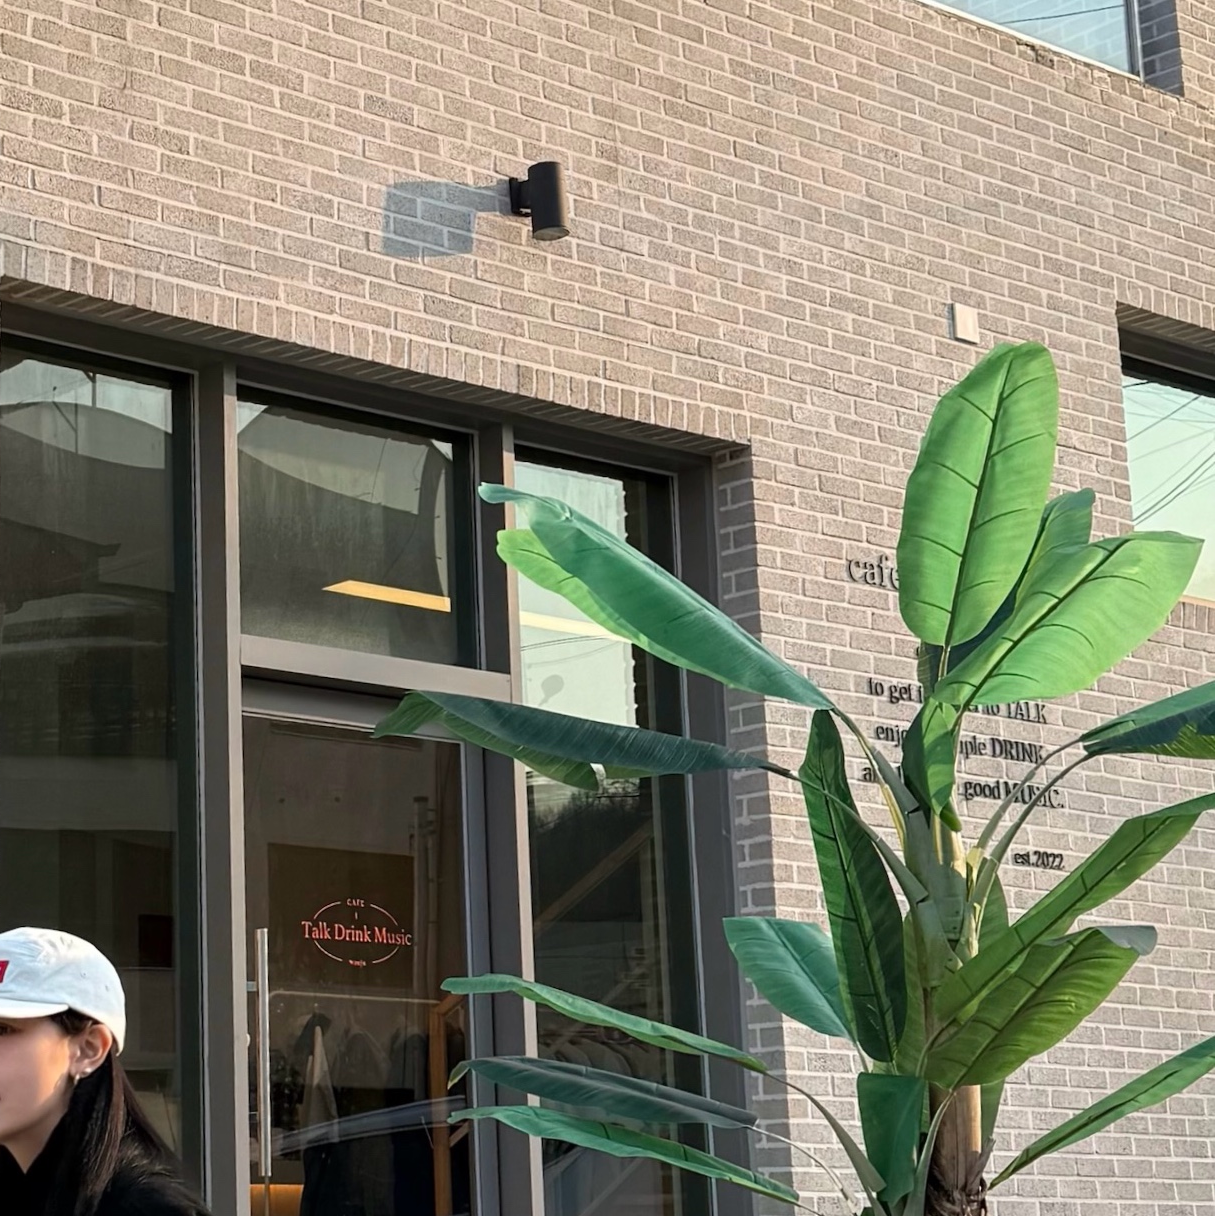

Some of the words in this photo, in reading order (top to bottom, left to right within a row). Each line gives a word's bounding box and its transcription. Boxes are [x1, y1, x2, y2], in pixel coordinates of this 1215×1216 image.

[868, 677, 885, 697] to
[889, 684, 914, 704] get
[990, 737, 1044, 766] DRINK
[964, 779, 1002, 801] good
[301, 920, 332, 940] Talk
[334, 923, 372, 943] Drink
[374, 926, 413, 946] Music
